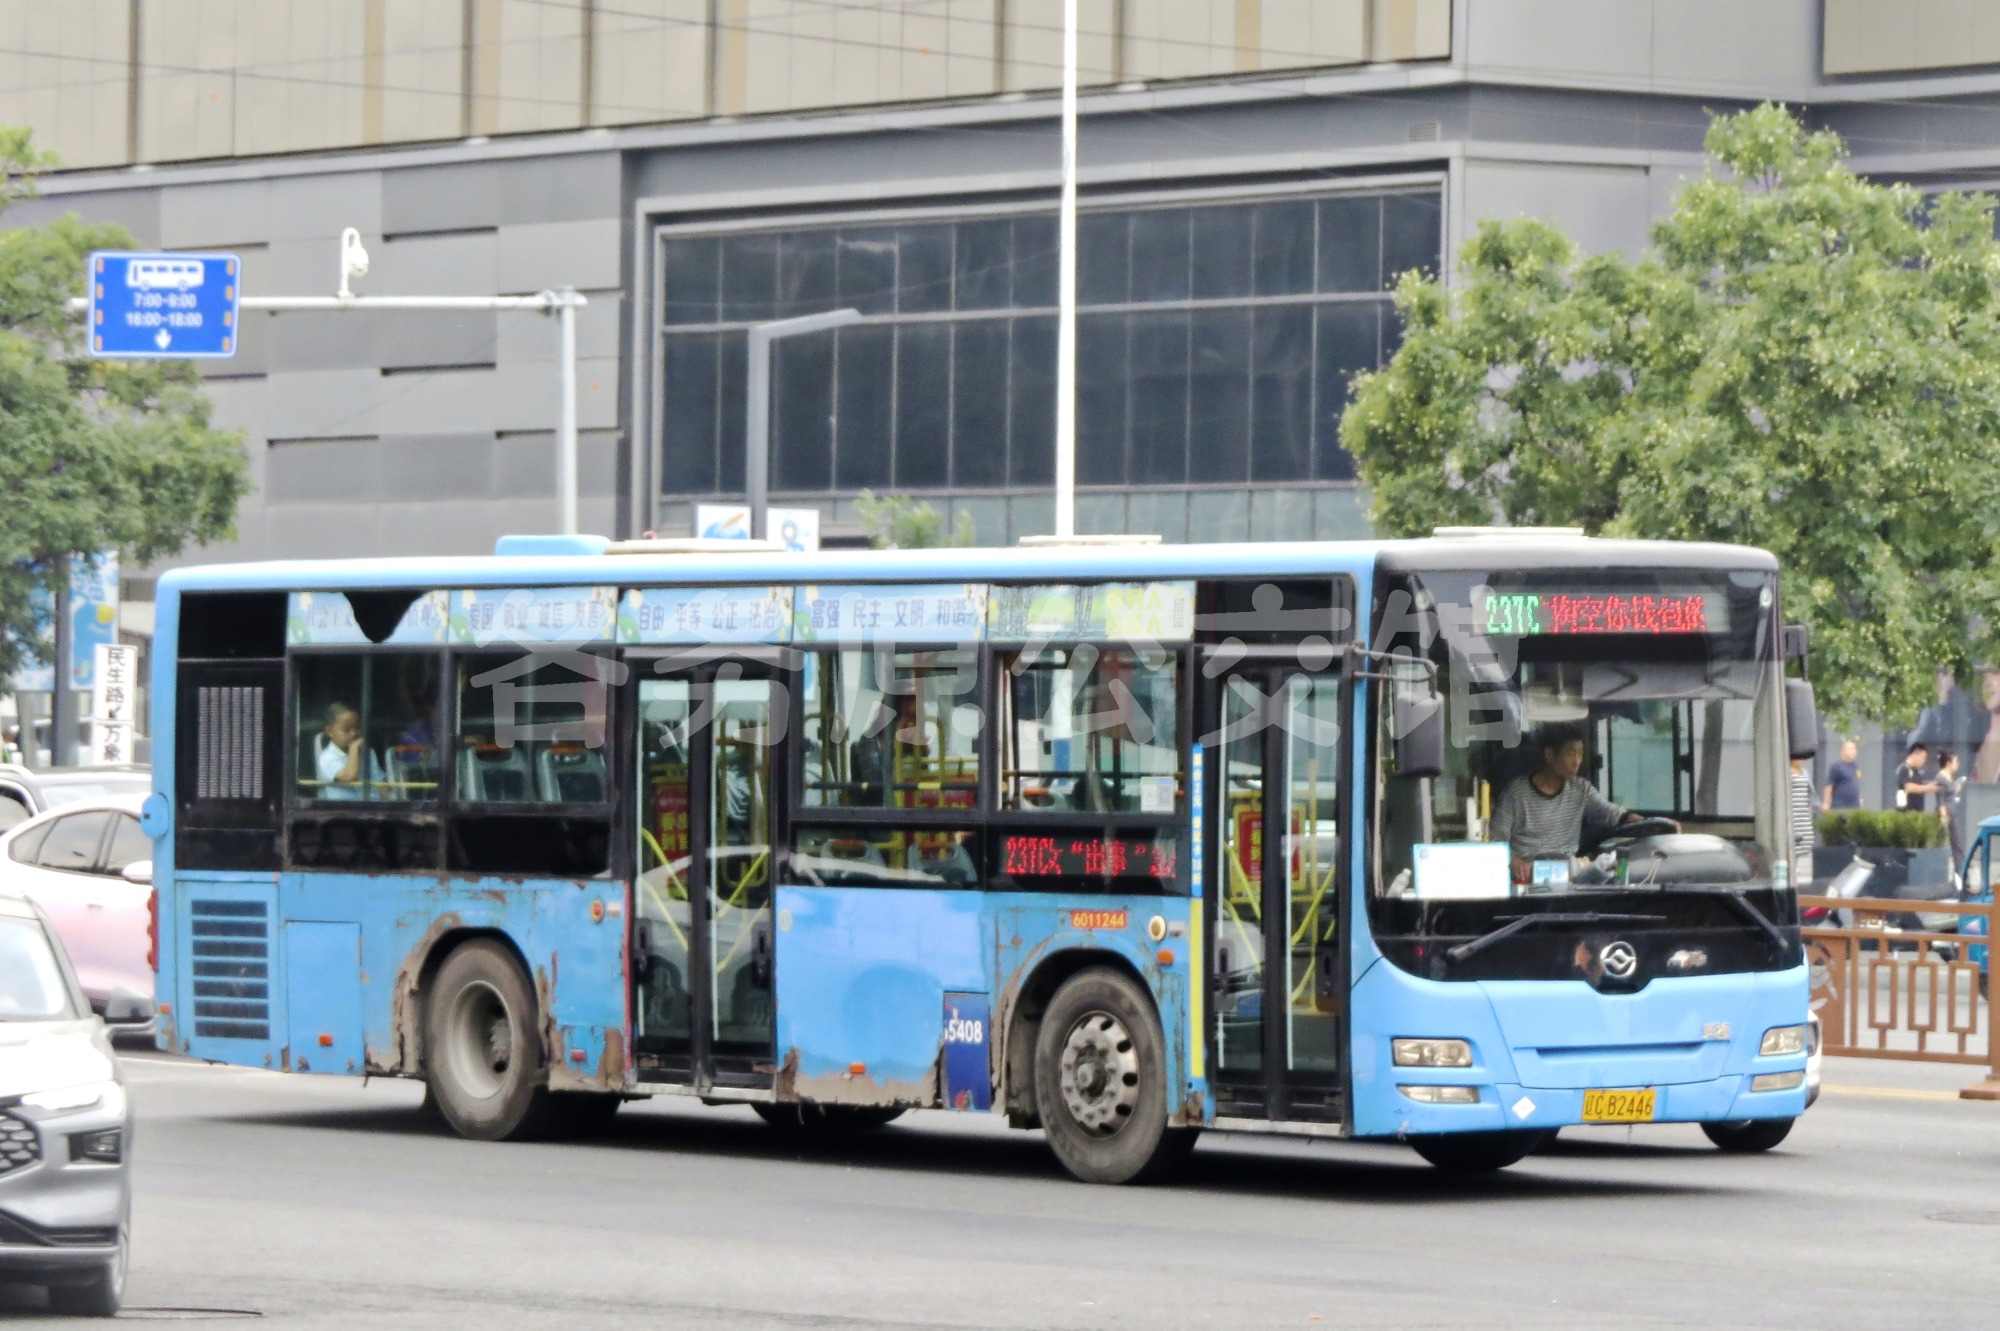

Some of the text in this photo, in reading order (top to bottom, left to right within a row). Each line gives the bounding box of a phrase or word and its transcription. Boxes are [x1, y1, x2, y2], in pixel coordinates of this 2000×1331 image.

[469, 602, 494, 630] 爱国
[504, 602, 529, 630] 敬业
[538, 600, 564, 630] 诚信
[638, 600, 776, 632] 自由 平等 公正 法治
[811, 597, 966, 630] 富强 民主 文明 和谐
[1486, 595, 1540, 633] 237C
[1540, 595, 1707, 633] 掏空你钱包的
[105, 647, 126, 703] 民生路
[1072, 912, 1125, 928] 6011244
